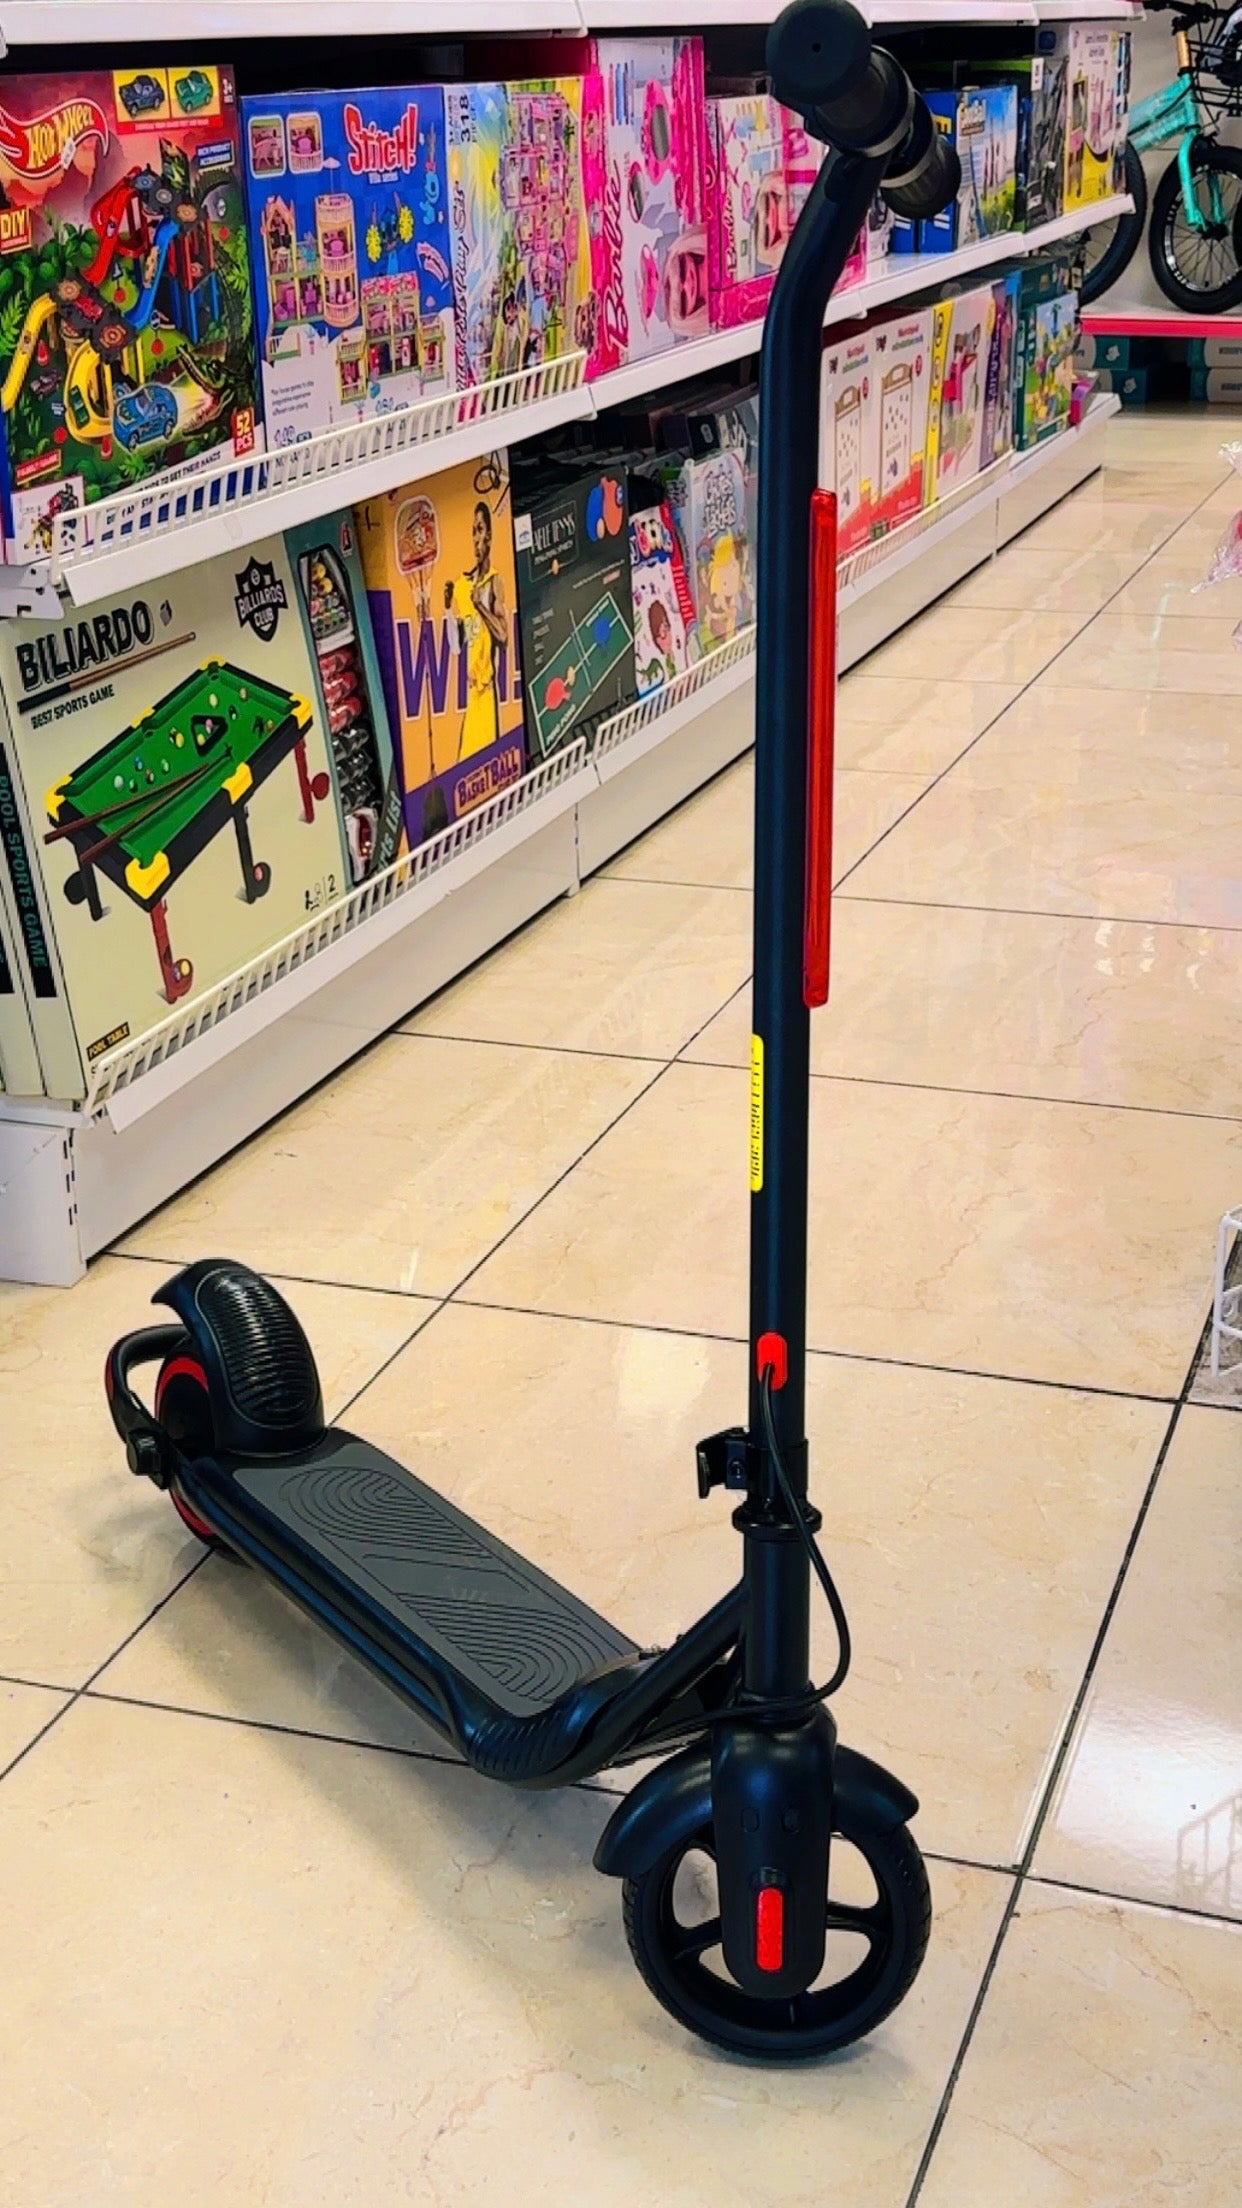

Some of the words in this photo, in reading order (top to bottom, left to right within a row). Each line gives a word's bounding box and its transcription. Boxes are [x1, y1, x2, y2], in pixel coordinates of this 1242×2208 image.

[459, 94, 471, 143] 318
[0, 209, 25, 240] DIY
[603, 160, 629, 350] Barbie
[237, 411, 250, 437] 52
[237, 433, 253, 451] PCS
[237, 584, 284, 620] BILLIARDS
[254, 607, 274, 627] CLUB
[17, 600, 154, 692] BILIARDO
[30, 708, 53, 730] BEST
[53, 695, 88, 720] SPORTS
[88, 684, 115, 704] GAME
[8, 831, 33, 908] SPORTS
[23, 912, 48, 967] GAME
